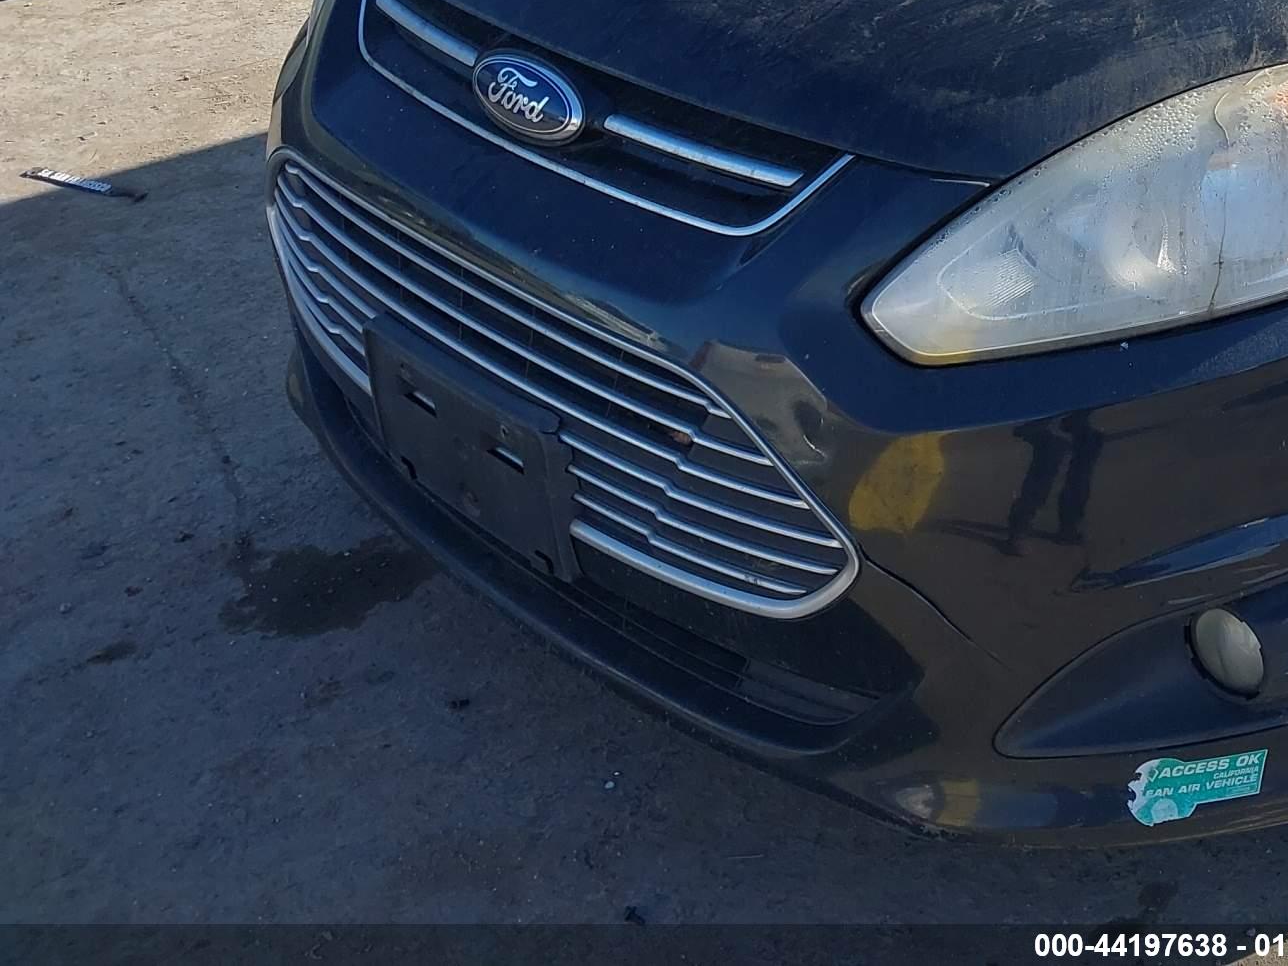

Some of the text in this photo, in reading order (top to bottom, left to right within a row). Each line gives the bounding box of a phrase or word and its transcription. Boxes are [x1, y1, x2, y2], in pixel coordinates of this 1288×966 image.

[488, 67, 551, 123] Ford
[1158, 753, 1260, 779] ACCESS OK
[1213, 766, 1259, 780] CALIFORNIA
[1178, 783, 1201, 794] AIR
[1206, 773, 1258, 790] VEHICLE
